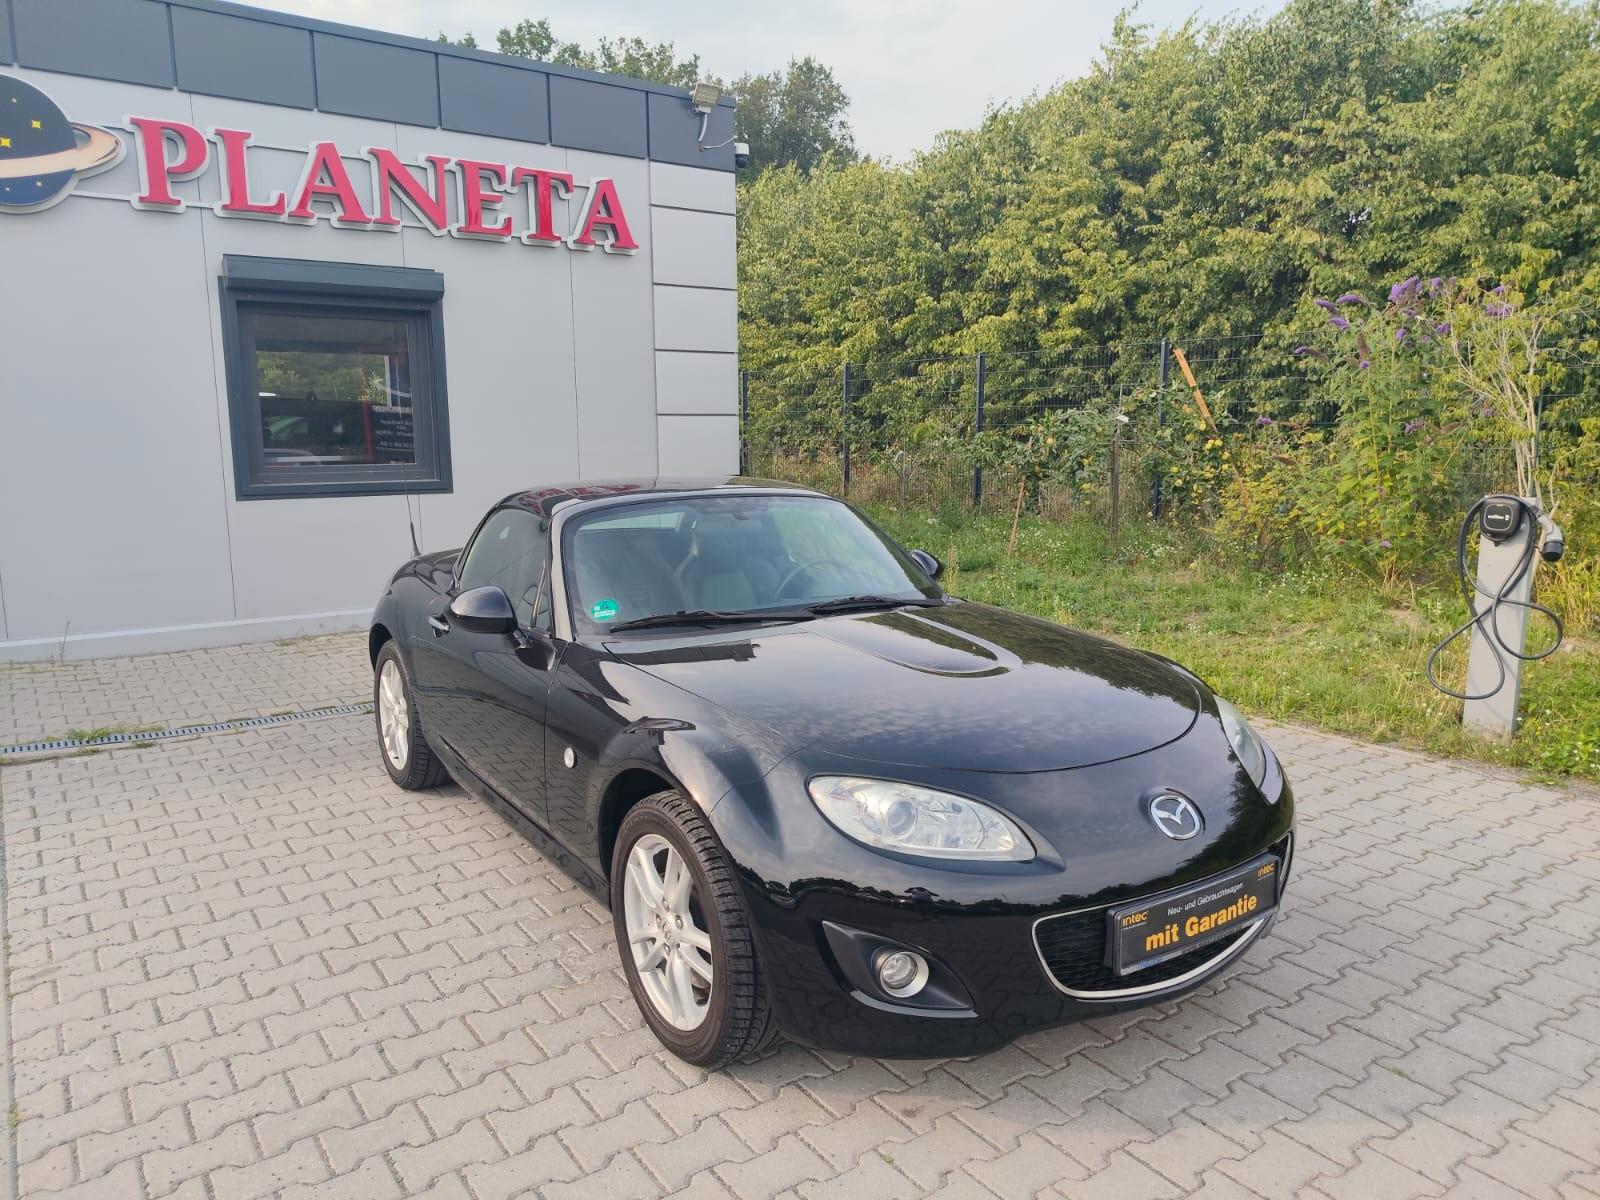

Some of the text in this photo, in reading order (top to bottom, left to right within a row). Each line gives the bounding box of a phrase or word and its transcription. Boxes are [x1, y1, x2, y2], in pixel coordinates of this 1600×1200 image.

[129, 116, 639, 251] PLANETA
[1122, 911, 1148, 927] intec
[1167, 882, 1244, 917] Neu- und Gebrauchtwagen
[1145, 923, 1180, 952] mit
[1184, 895, 1258, 938] Garantie
